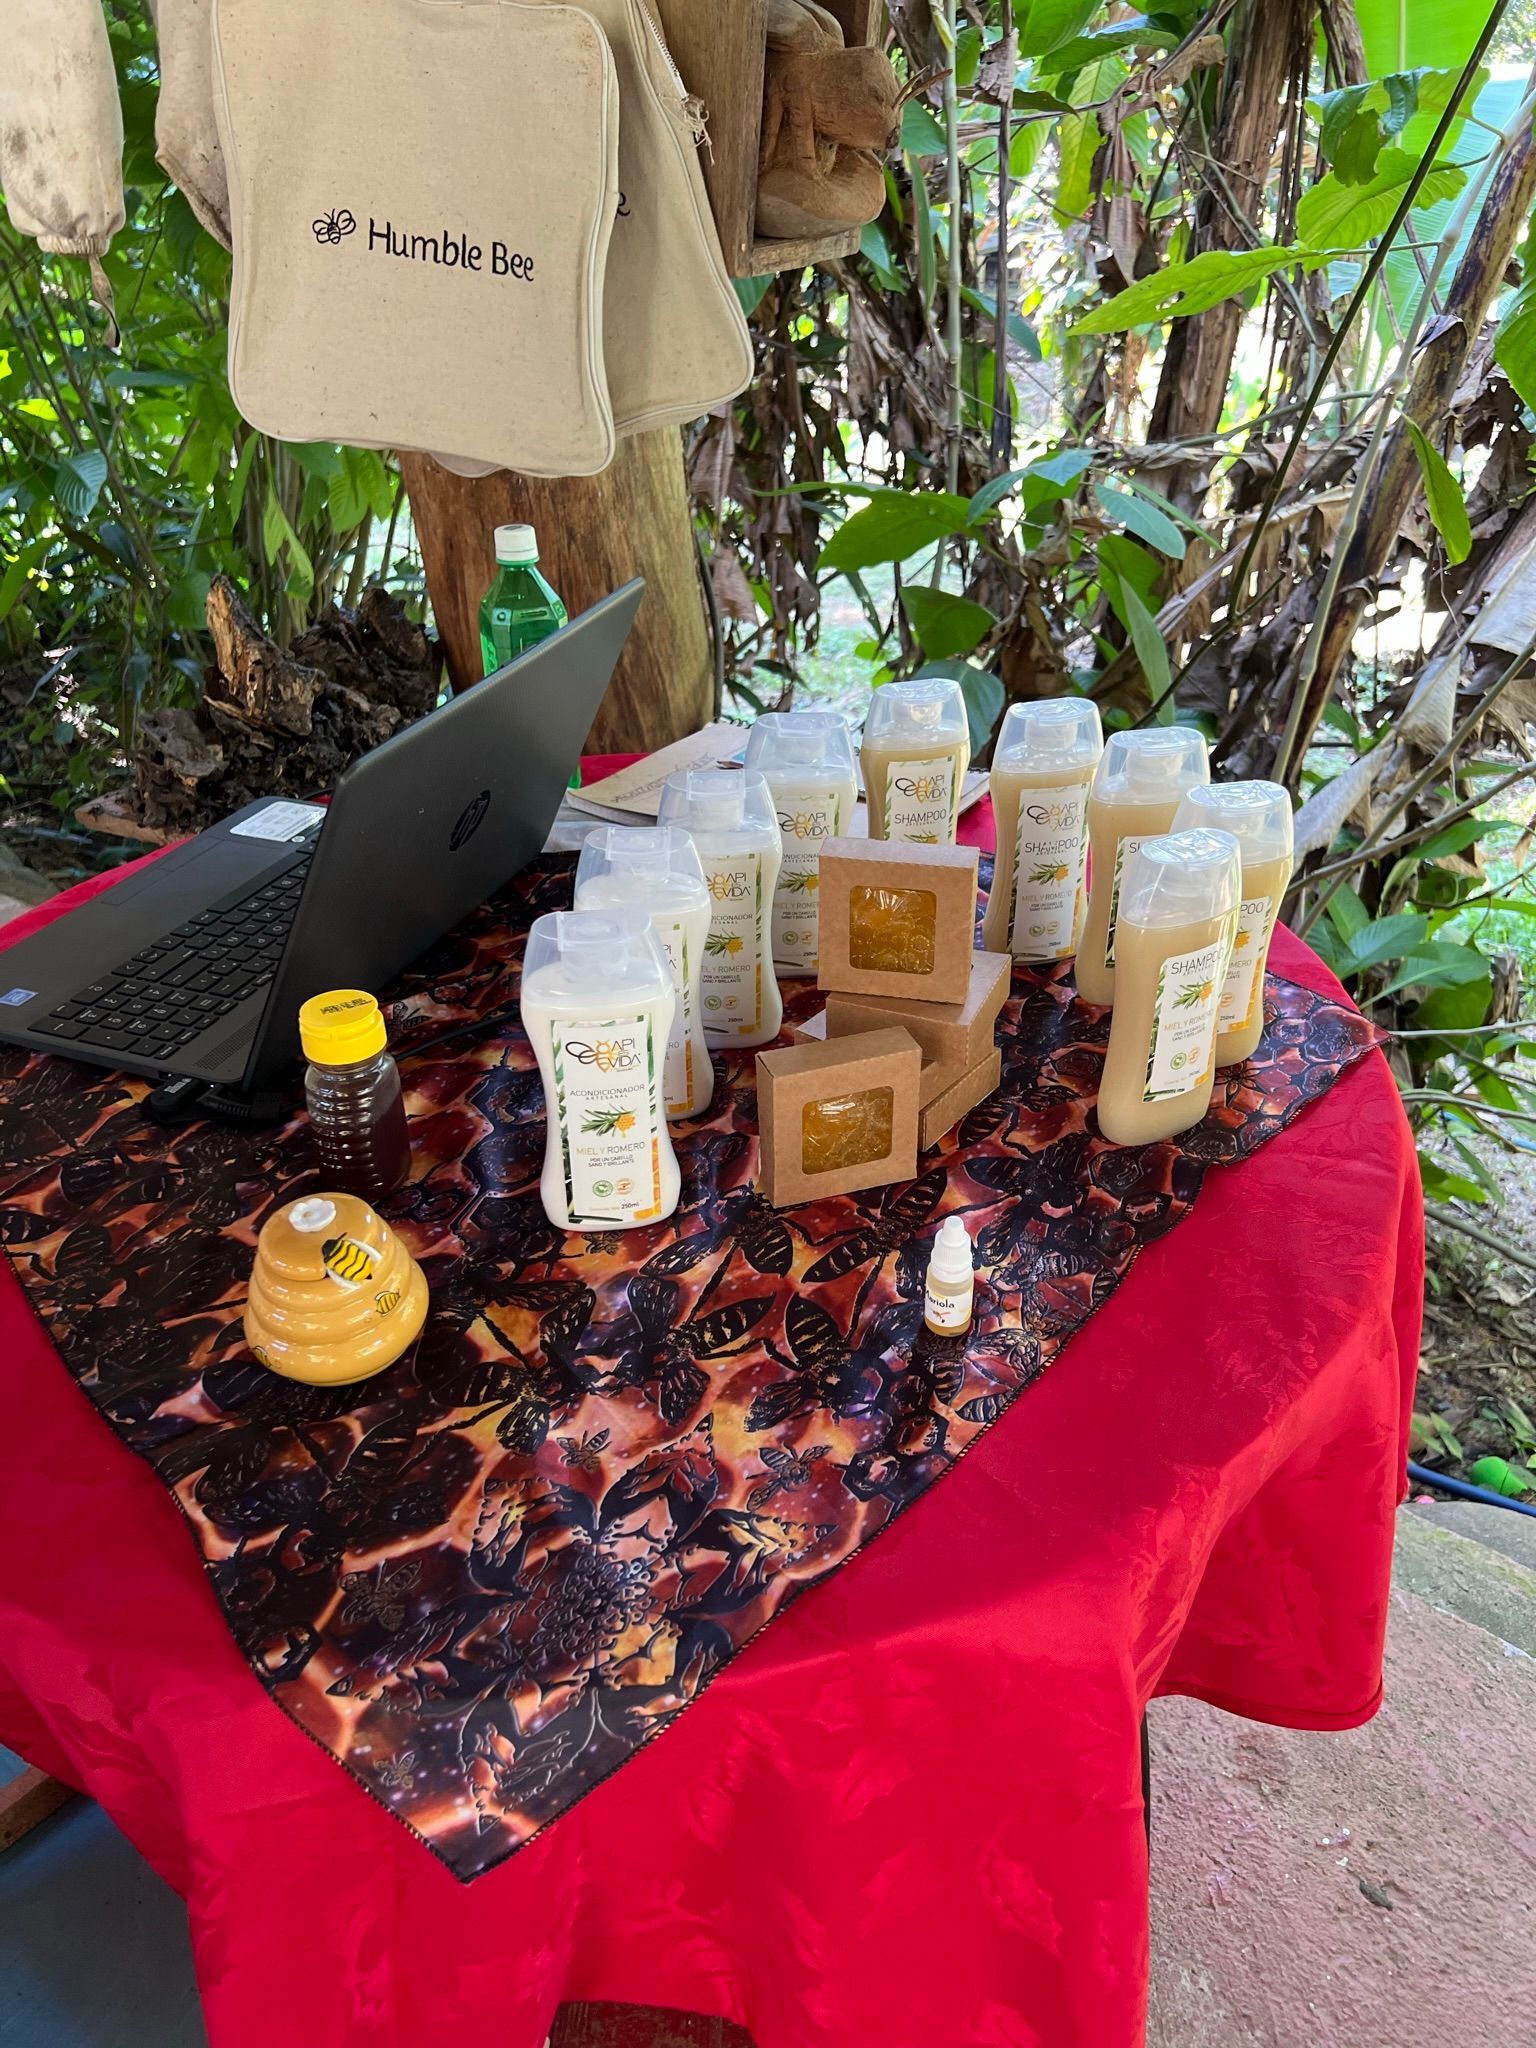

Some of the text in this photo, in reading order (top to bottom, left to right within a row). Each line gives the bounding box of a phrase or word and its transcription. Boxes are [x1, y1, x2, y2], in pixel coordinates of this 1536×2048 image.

[368, 217, 535, 282] Humble Bee
[928, 774, 945, 785] API
[924, 787, 947, 799] VIDA
[807, 812, 826, 823] API
[894, 808, 947, 825] SHAMPOO
[803, 825, 829, 837] VIDA
[1024, 836, 1079, 853] SHAMPOO
[726, 872, 747, 883] API
[722, 886, 751, 897] VIDA
[718, 964, 751, 973] ROMERO
[611, 1038, 636, 1052] API
[607, 1053, 641, 1068] VIDA
[569, 1083, 646, 1097] ACONDICIONADOR
[576, 1147, 599, 1155] MIEL
[607, 1141, 646, 1154] ROMERO
